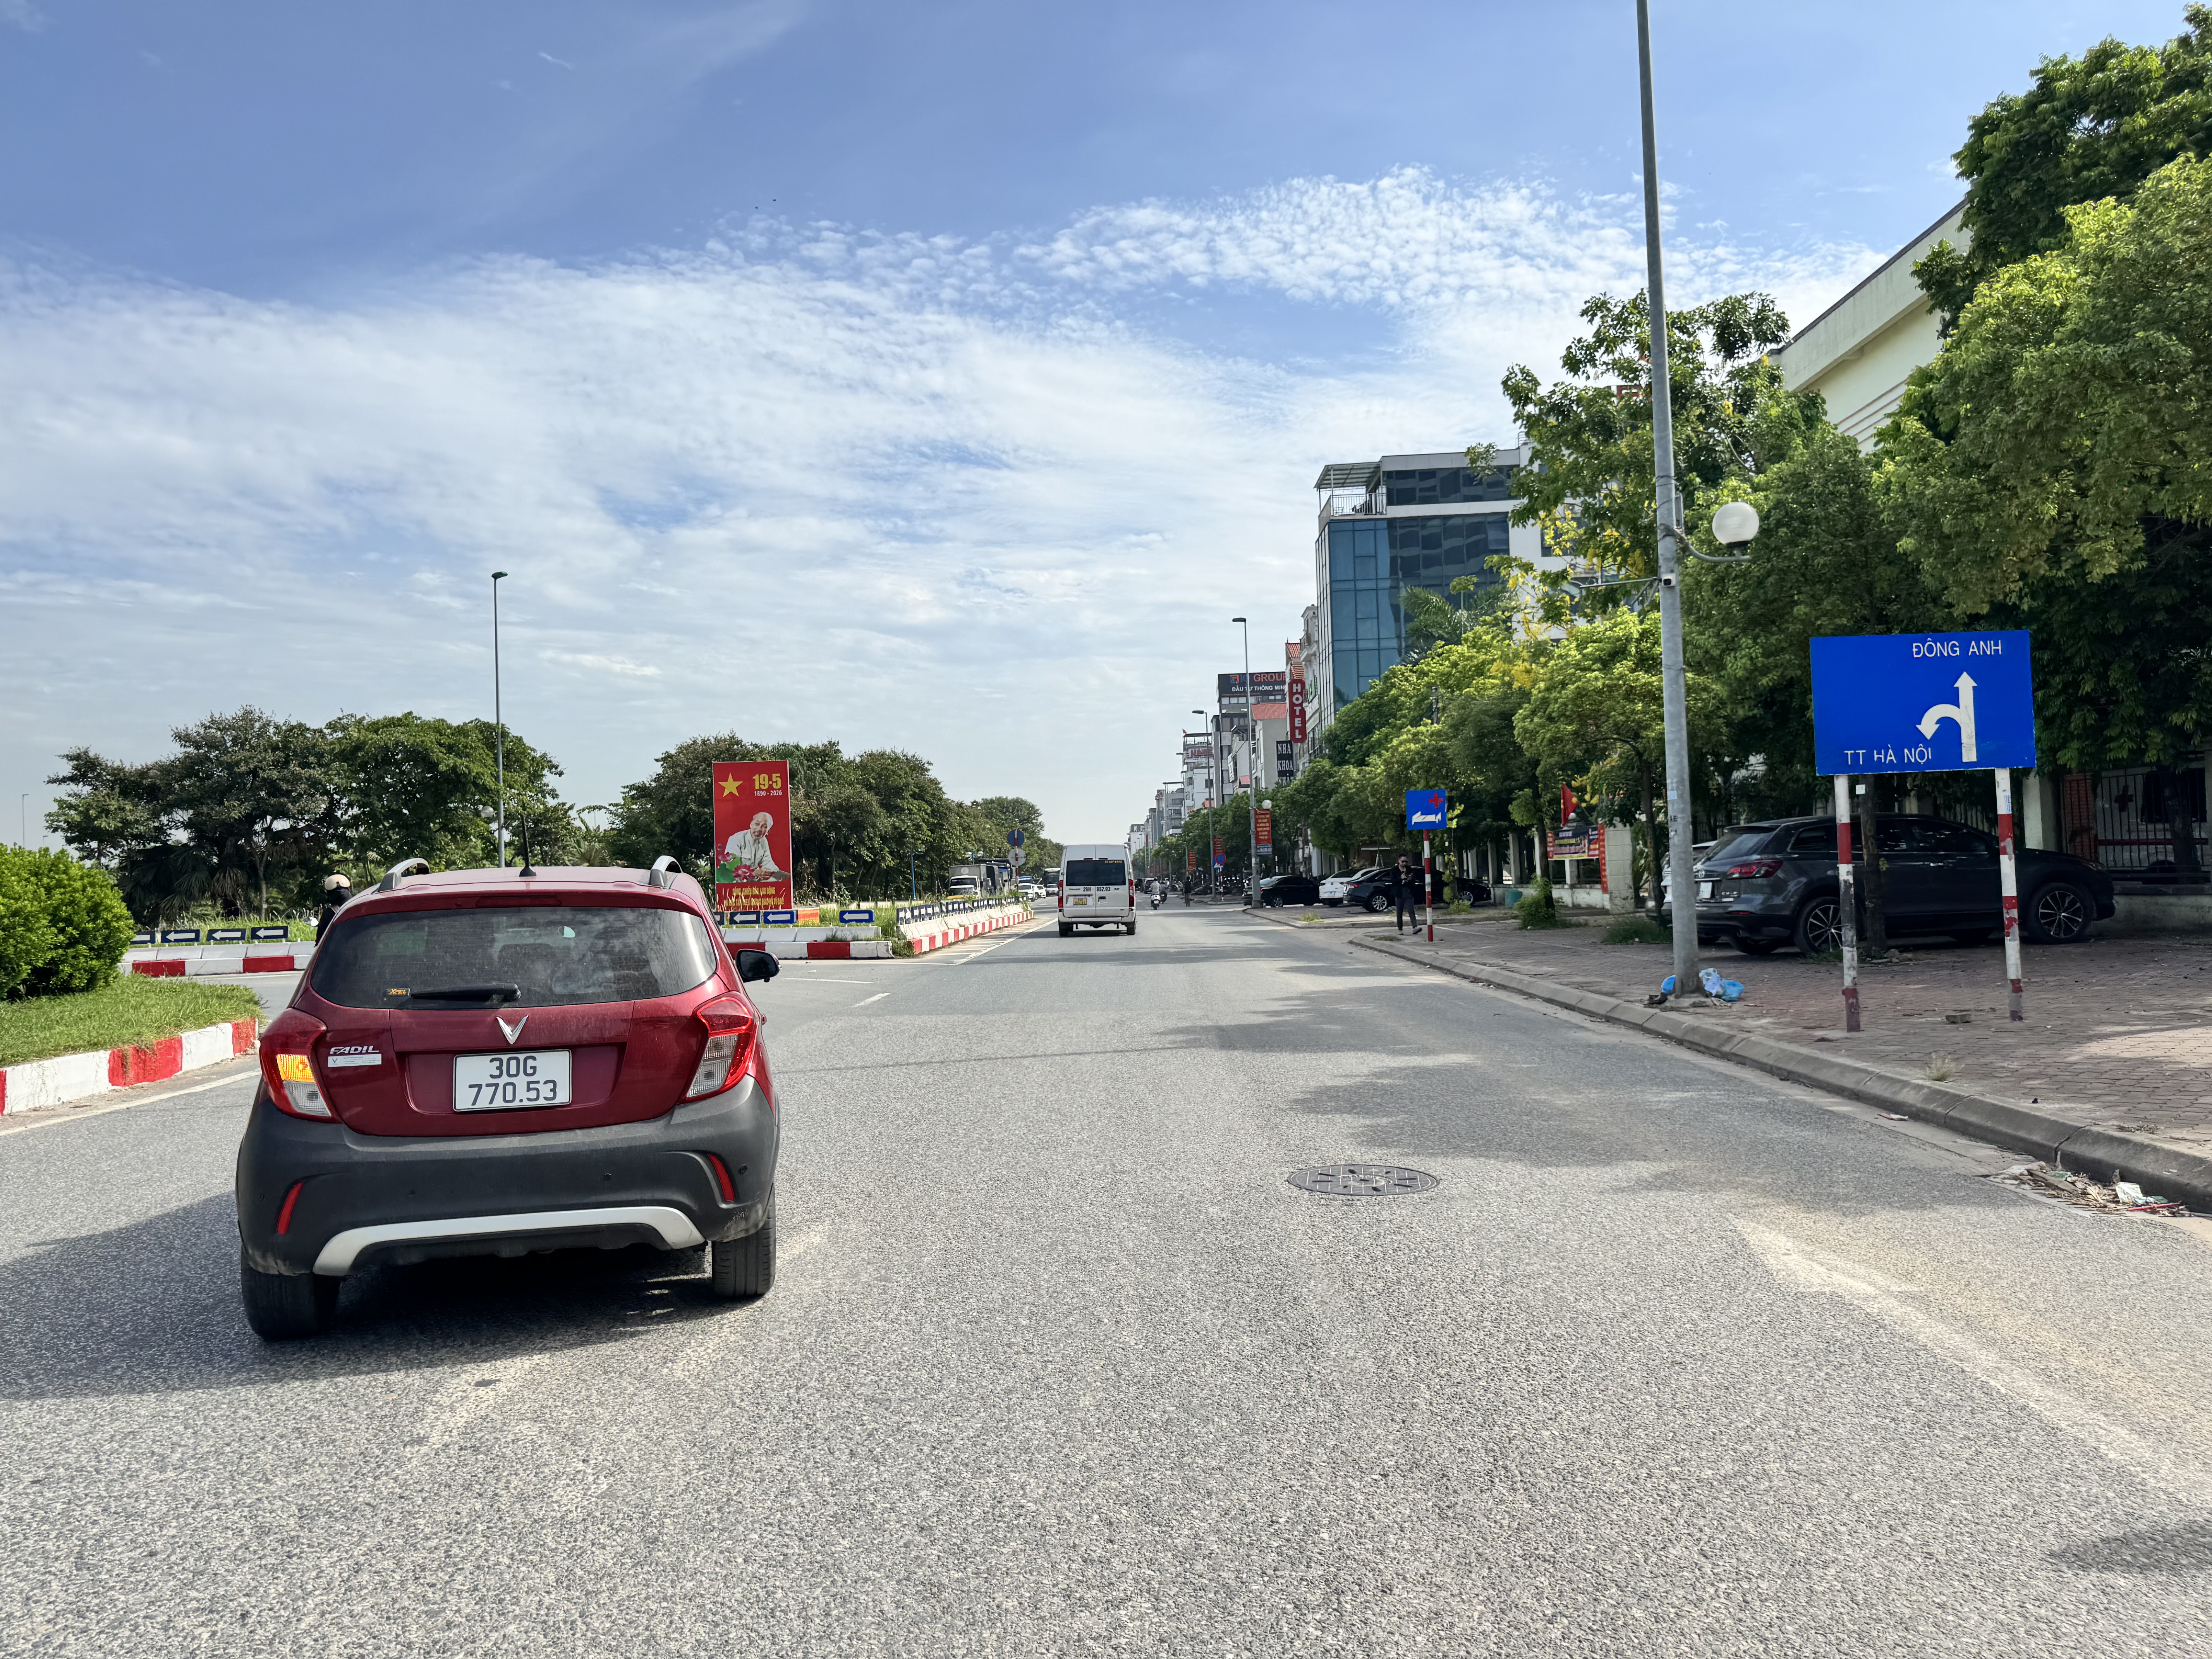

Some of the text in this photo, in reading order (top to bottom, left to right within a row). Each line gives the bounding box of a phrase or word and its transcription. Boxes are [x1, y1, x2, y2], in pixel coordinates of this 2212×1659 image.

[1912, 638, 2002, 658] ĐÔNG ANH
[1292, 683, 1302, 738] HOTEL
[1278, 743, 1291, 754] NHA
[1844, 744, 1932, 765] TT HÀ NỘI
[1278, 760, 1293, 771] KHOA
[330, 1045, 380, 1054] FADIL
[489, 1055, 537, 1079] 30G
[468, 1079, 557, 1106] 770.53
